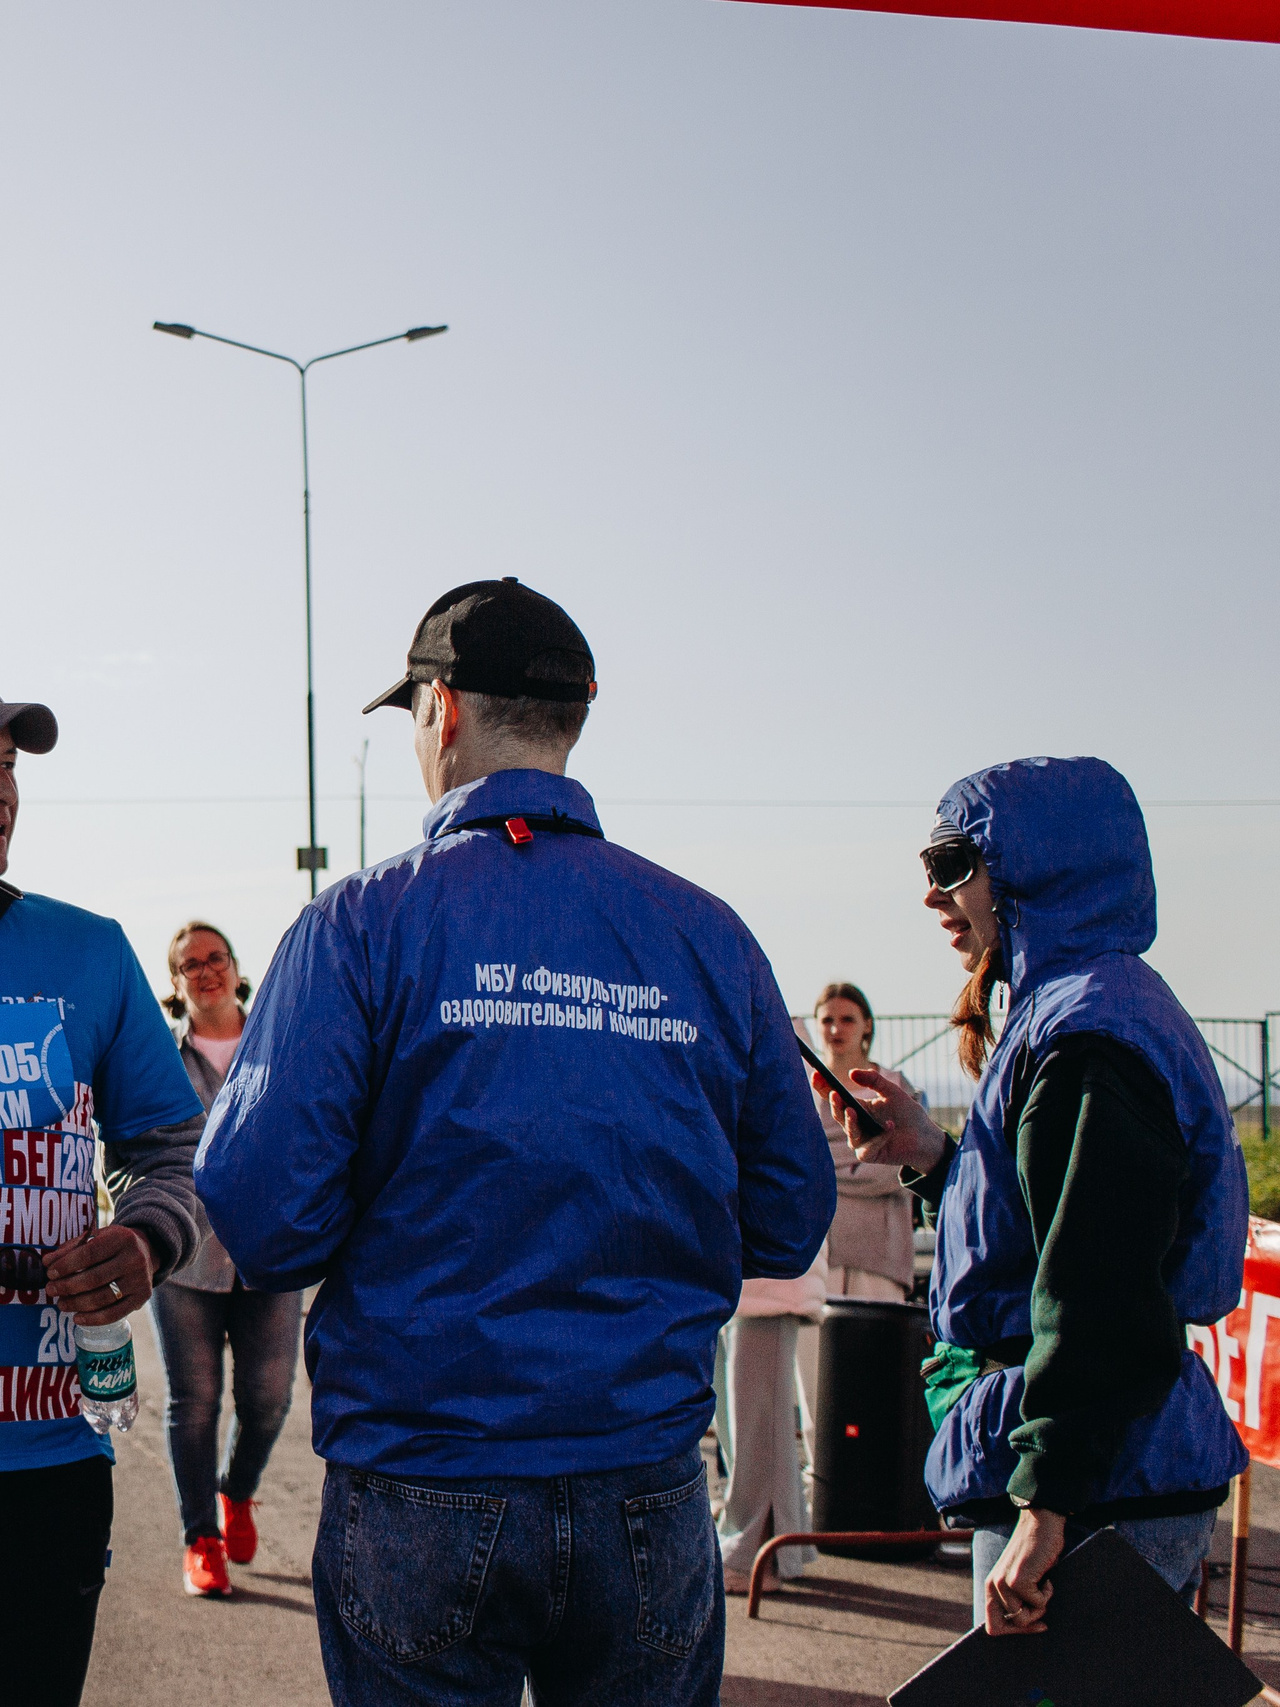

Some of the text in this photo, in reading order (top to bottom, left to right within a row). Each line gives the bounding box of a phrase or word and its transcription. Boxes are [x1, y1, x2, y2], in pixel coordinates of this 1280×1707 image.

[475, 963, 668, 1012] МБУ «Физкультурно-
[440, 998, 603, 1031] оздоровительный
